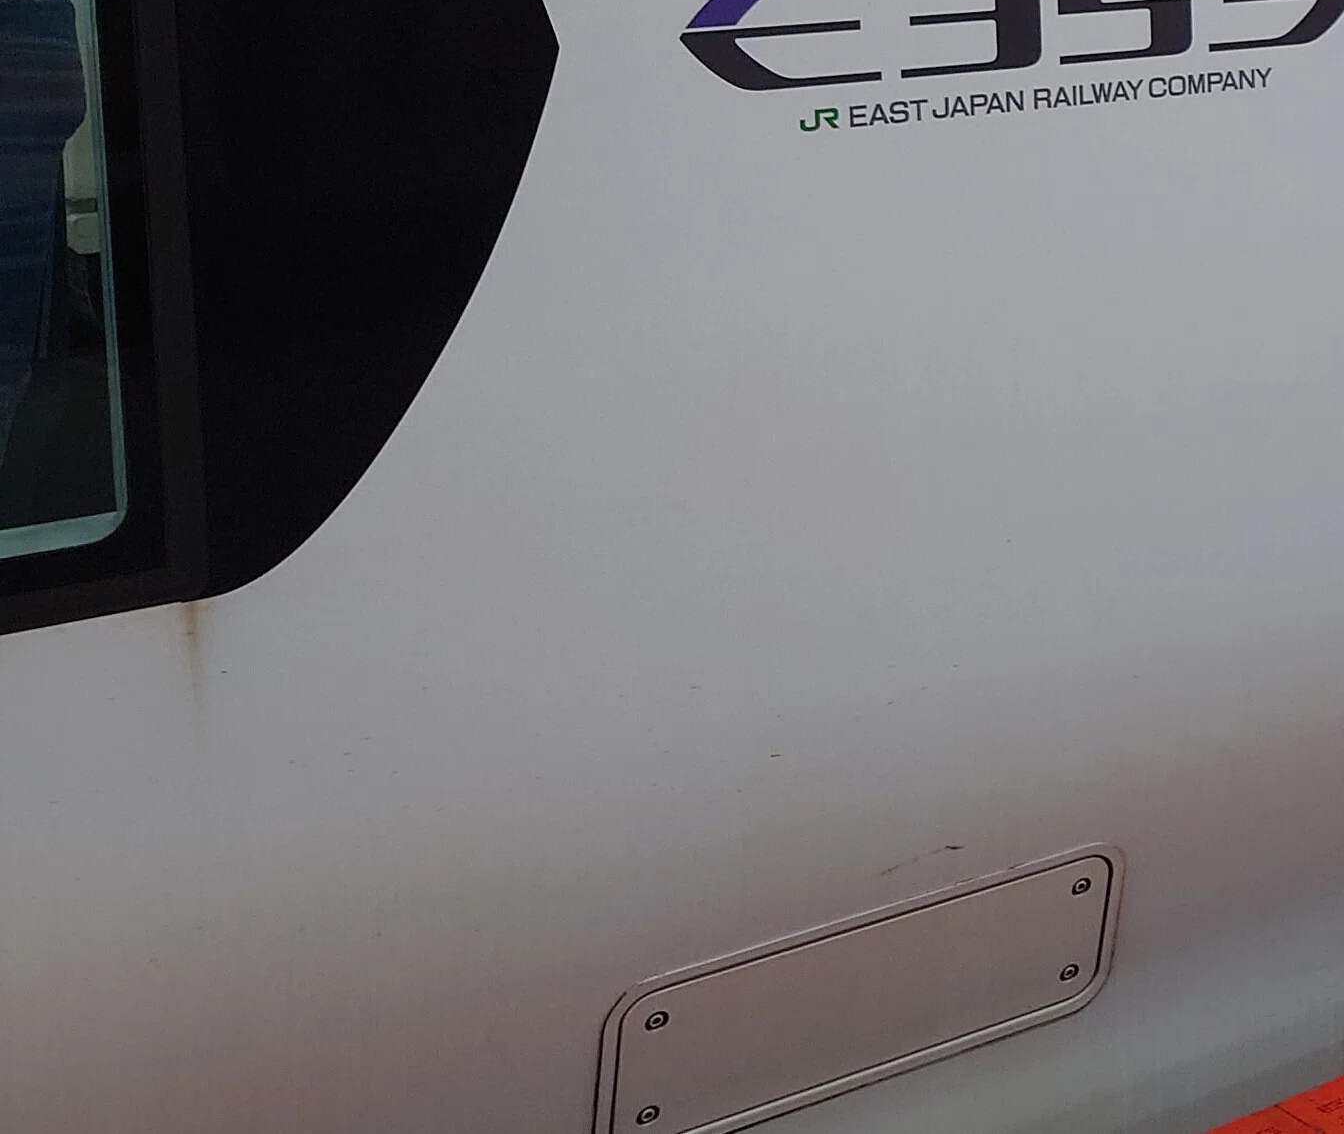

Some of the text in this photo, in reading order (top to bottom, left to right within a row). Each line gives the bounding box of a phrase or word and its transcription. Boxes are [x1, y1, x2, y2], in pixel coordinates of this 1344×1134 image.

[800, 67, 1272, 132] JR EAST JAPAN RAILWAY COMPANY
